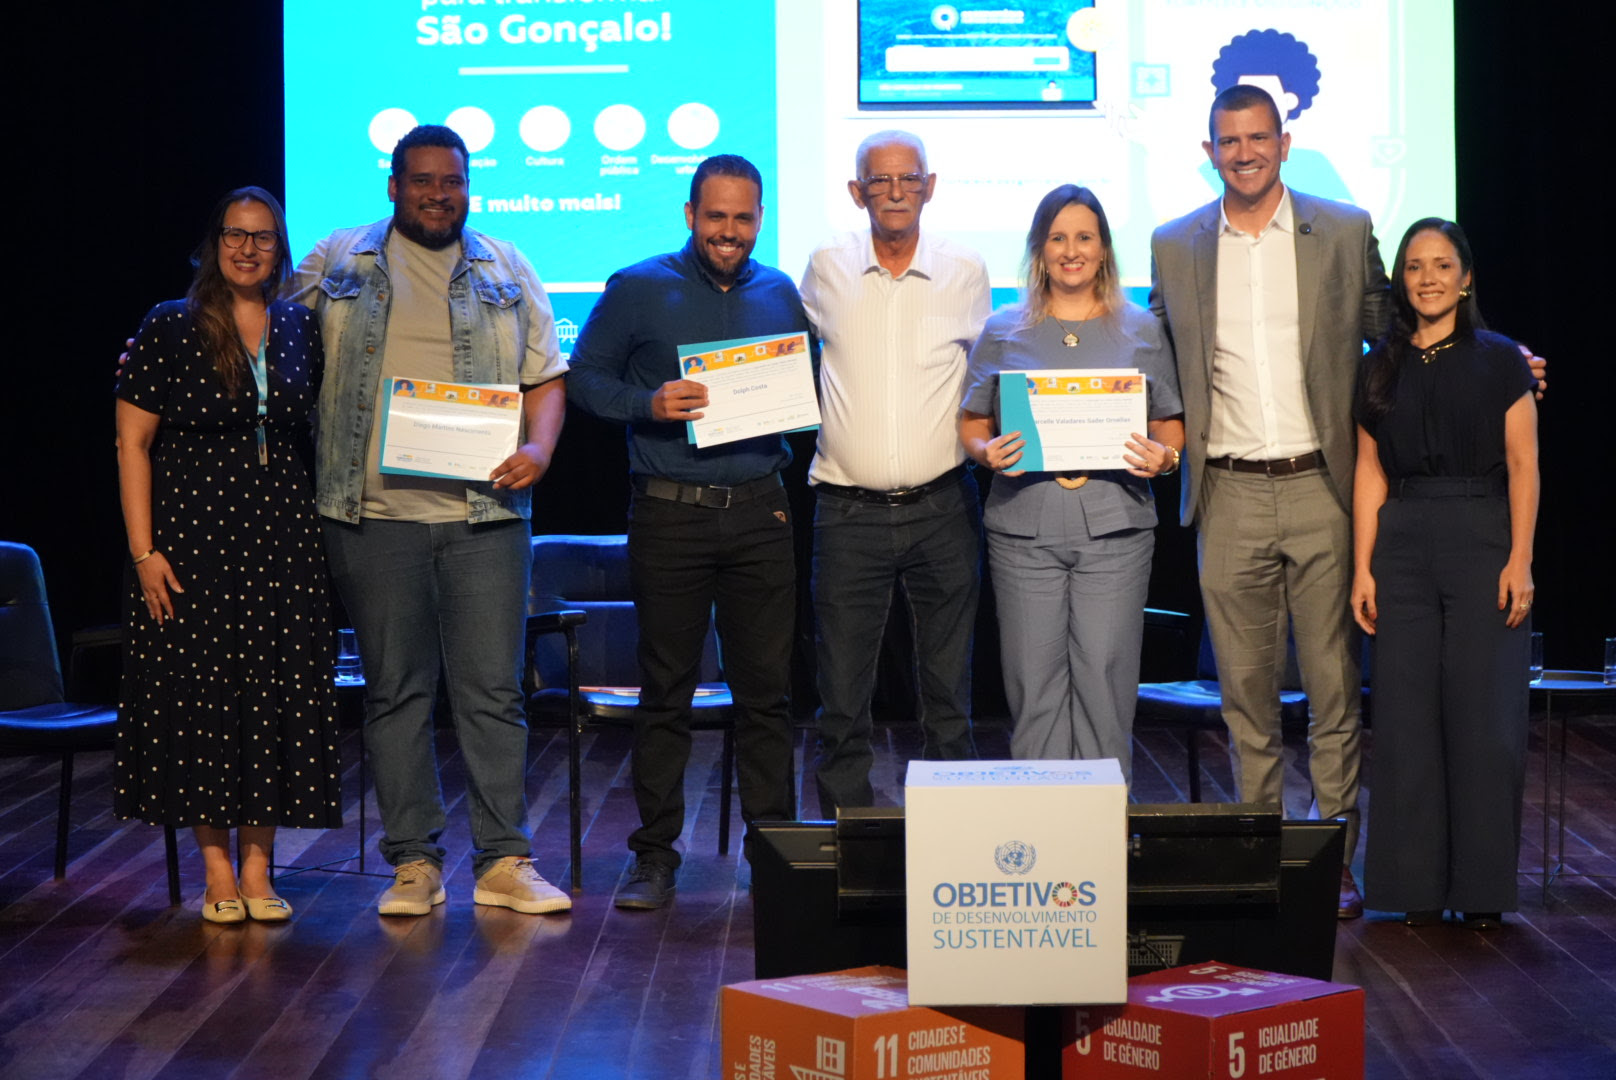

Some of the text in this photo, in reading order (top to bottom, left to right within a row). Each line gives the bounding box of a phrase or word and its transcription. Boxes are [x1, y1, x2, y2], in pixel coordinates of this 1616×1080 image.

[416, 11, 672, 53] São Gonçalo!
[525, 156, 565, 167] Cultura
[601, 154, 638, 165] Ordem
[469, 192, 622, 213] E muito mais!
[732, 383, 768, 396] Dolph Costa
[413, 421, 432, 430] Diego
[1087, 417, 1104, 425] Sader
[933, 881, 1097, 908] OBJETIVOS
[933, 910, 1097, 925] DE DESENVOLVIMENTO
[933, 924, 1098, 949] SUSTENTÁVEL
[908, 1025, 967, 1050] CIDADES E
[1075, 1010, 1091, 1056] 5
[1103, 1015, 1163, 1045] IGUALDADE
[1259, 1018, 1319, 1048] IGUALDADE
[873, 1033, 899, 1079] 11
[907, 1045, 991, 1075] COMUNIDADES
[1103, 1041, 1118, 1063] DE
[1229, 1031, 1246, 1079] 5
[1259, 1052, 1274, 1075] DE
